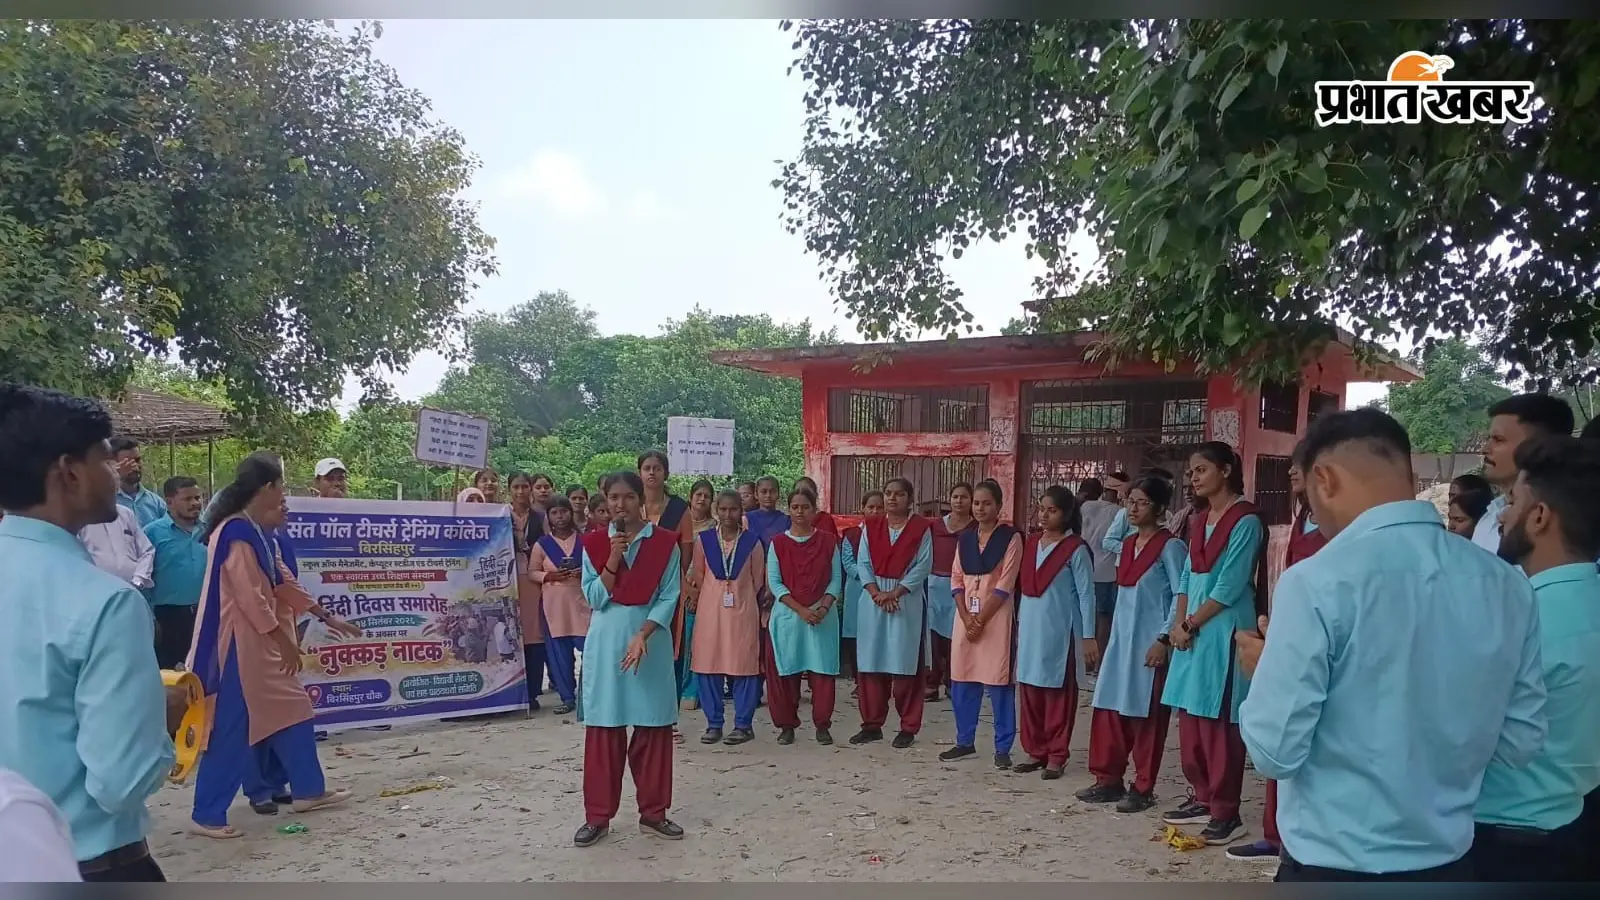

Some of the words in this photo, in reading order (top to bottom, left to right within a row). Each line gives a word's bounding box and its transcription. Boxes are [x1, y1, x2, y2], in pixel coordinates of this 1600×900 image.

[287, 517, 317, 538] संत
[320, 517, 353, 538] पॉल
[356, 518, 398, 538] टीचर्स
[401, 518, 441, 541] ट्रेनिंग
[443, 519, 490, 540] कॉलेज
[359, 540, 416, 556] बिरसिंहपुर
[330, 573, 344, 581] एक
[411, 571, 435, 579] संस्थान
[318, 594, 351, 616] हिंदी
[354, 594, 395, 615] दिवस
[398, 593, 448, 615] समारोह
[368, 616, 393, 627] सितंबर
[375, 630, 397, 638] अवसर
[398, 629, 408, 637] पर
